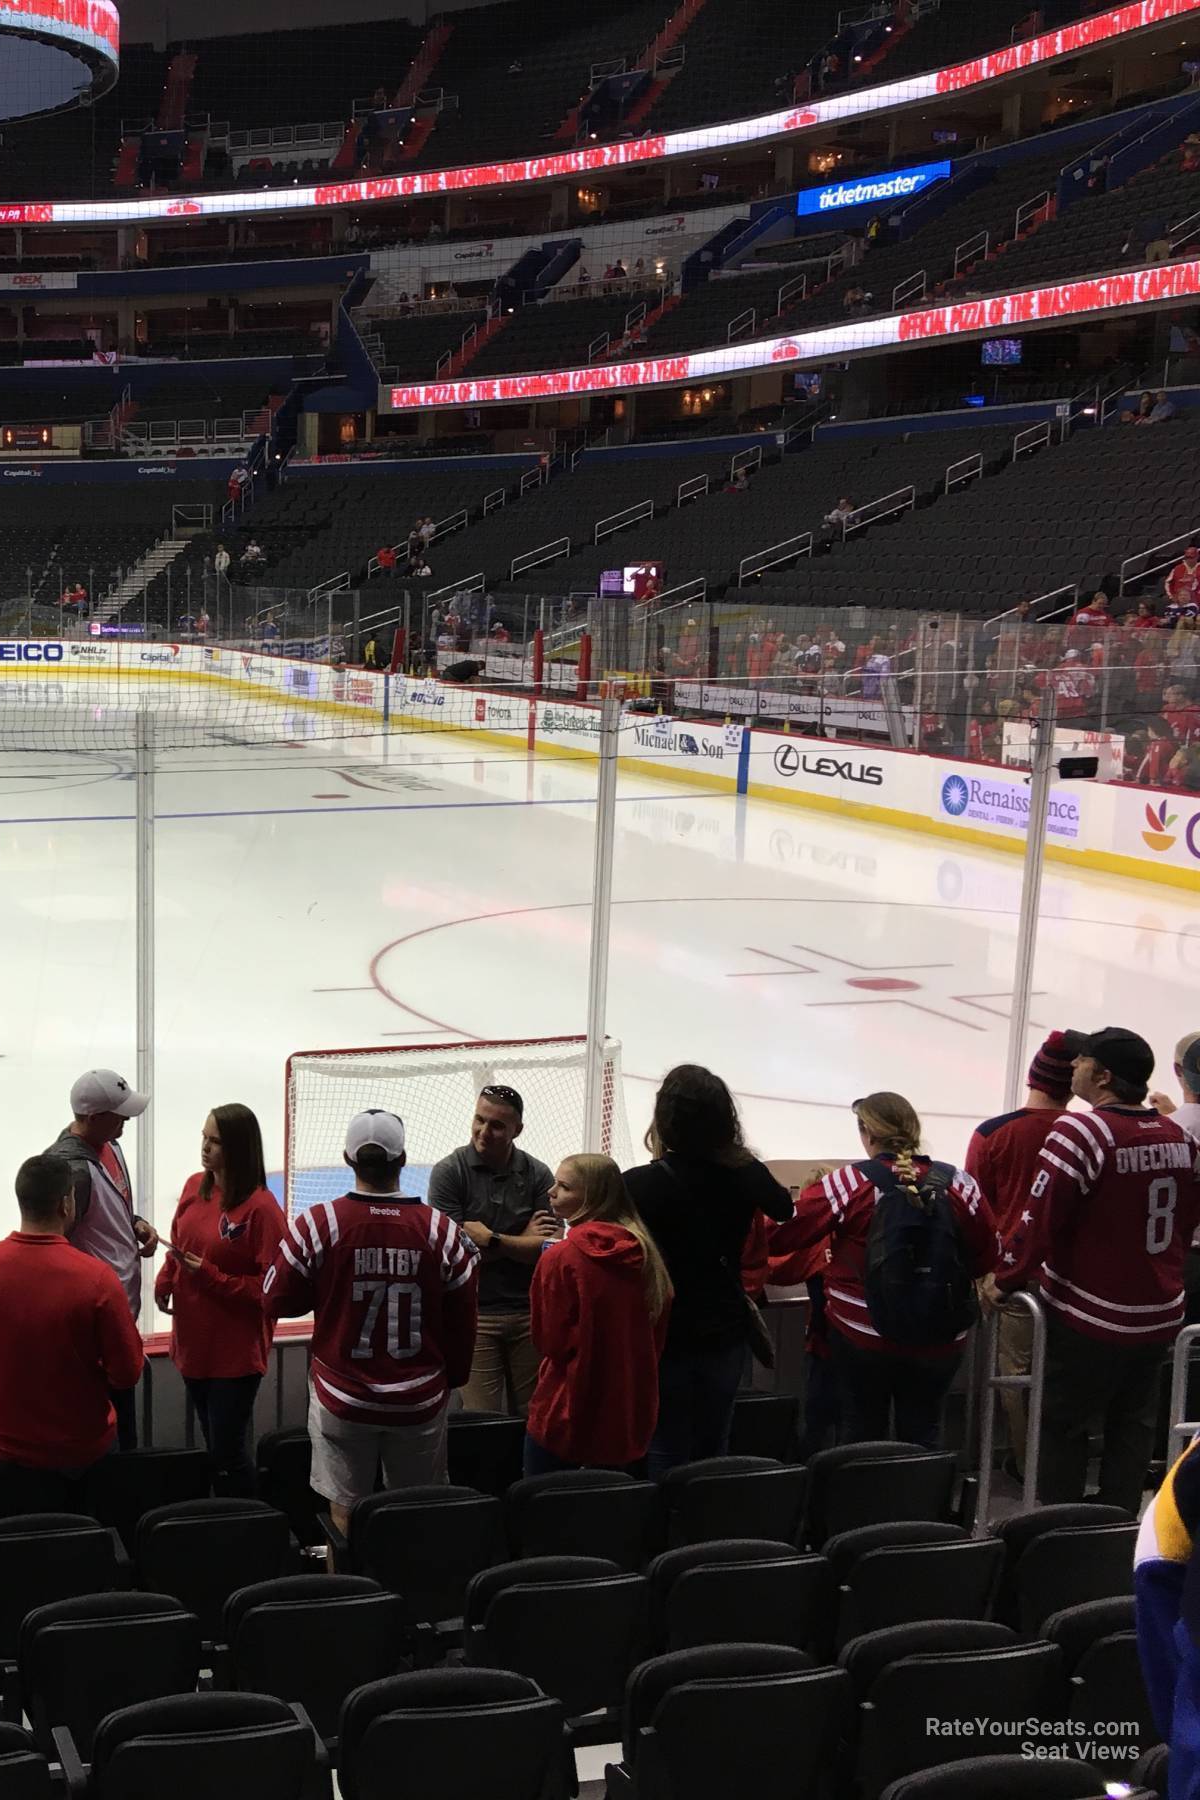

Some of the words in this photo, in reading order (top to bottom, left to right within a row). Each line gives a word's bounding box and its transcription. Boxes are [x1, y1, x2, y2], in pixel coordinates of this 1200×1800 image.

[936, 57, 981, 93] OFFICIAL
[987, 47, 1016, 77] PIZZA
[1036, 34, 1057, 61] THE
[1062, 2, 1142, 52] WASHINGTON
[314, 185, 361, 205] OFFICIAL
[366, 179, 398, 199] PIZZA
[421, 174, 440, 192] THE
[445, 163, 525, 189] WASHINGTON
[529, 153, 581, 178] CAPITALS
[819, 174, 920, 208] ticketmaster
[899, 308, 948, 340] OFFICIAL
[952, 301, 985, 331] PIZZA
[989, 298, 1006, 325] OF
[1009, 292, 1033, 322] THE
[1038, 274, 1135, 317] WASHINGTON
[425, 385, 455, 405] PIZZA
[458, 383, 473, 401] OF
[477, 381, 496, 400] THE
[500, 374, 569, 398] WASHINGTON
[572, 367, 617, 391] CAPITALS
[620, 363, 640, 385] FOR
[655, 357, 689, 381] YEARS!
[488, 706, 511, 720] TOYOTA
[701, 737, 724, 760] Son
[803, 755, 883, 786] LEXUS
[970, 780, 1078, 820] Renaissnce
[1030, 1169, 1050, 1198] 8
[1146, 1176, 1177, 1255] 8
[354, 1248, 422, 1276] HOLTBY
[352, 1280, 422, 1360] 70
